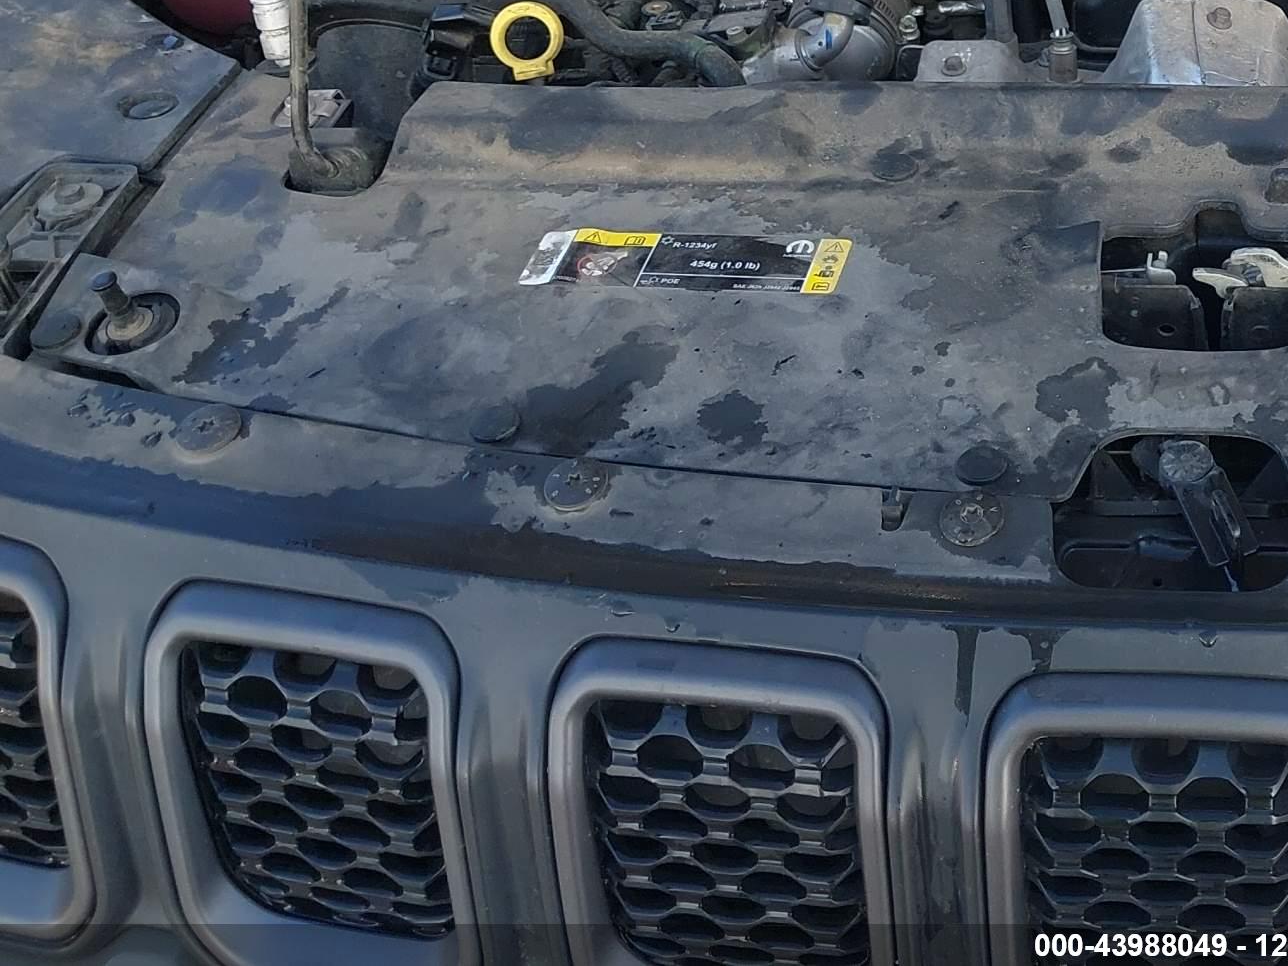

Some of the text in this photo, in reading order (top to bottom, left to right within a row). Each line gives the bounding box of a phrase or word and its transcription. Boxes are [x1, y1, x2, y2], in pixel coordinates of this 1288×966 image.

[672, 241, 718, 250] R-1234yf
[690, 260, 761, 271] 454g (1.0 lb)
